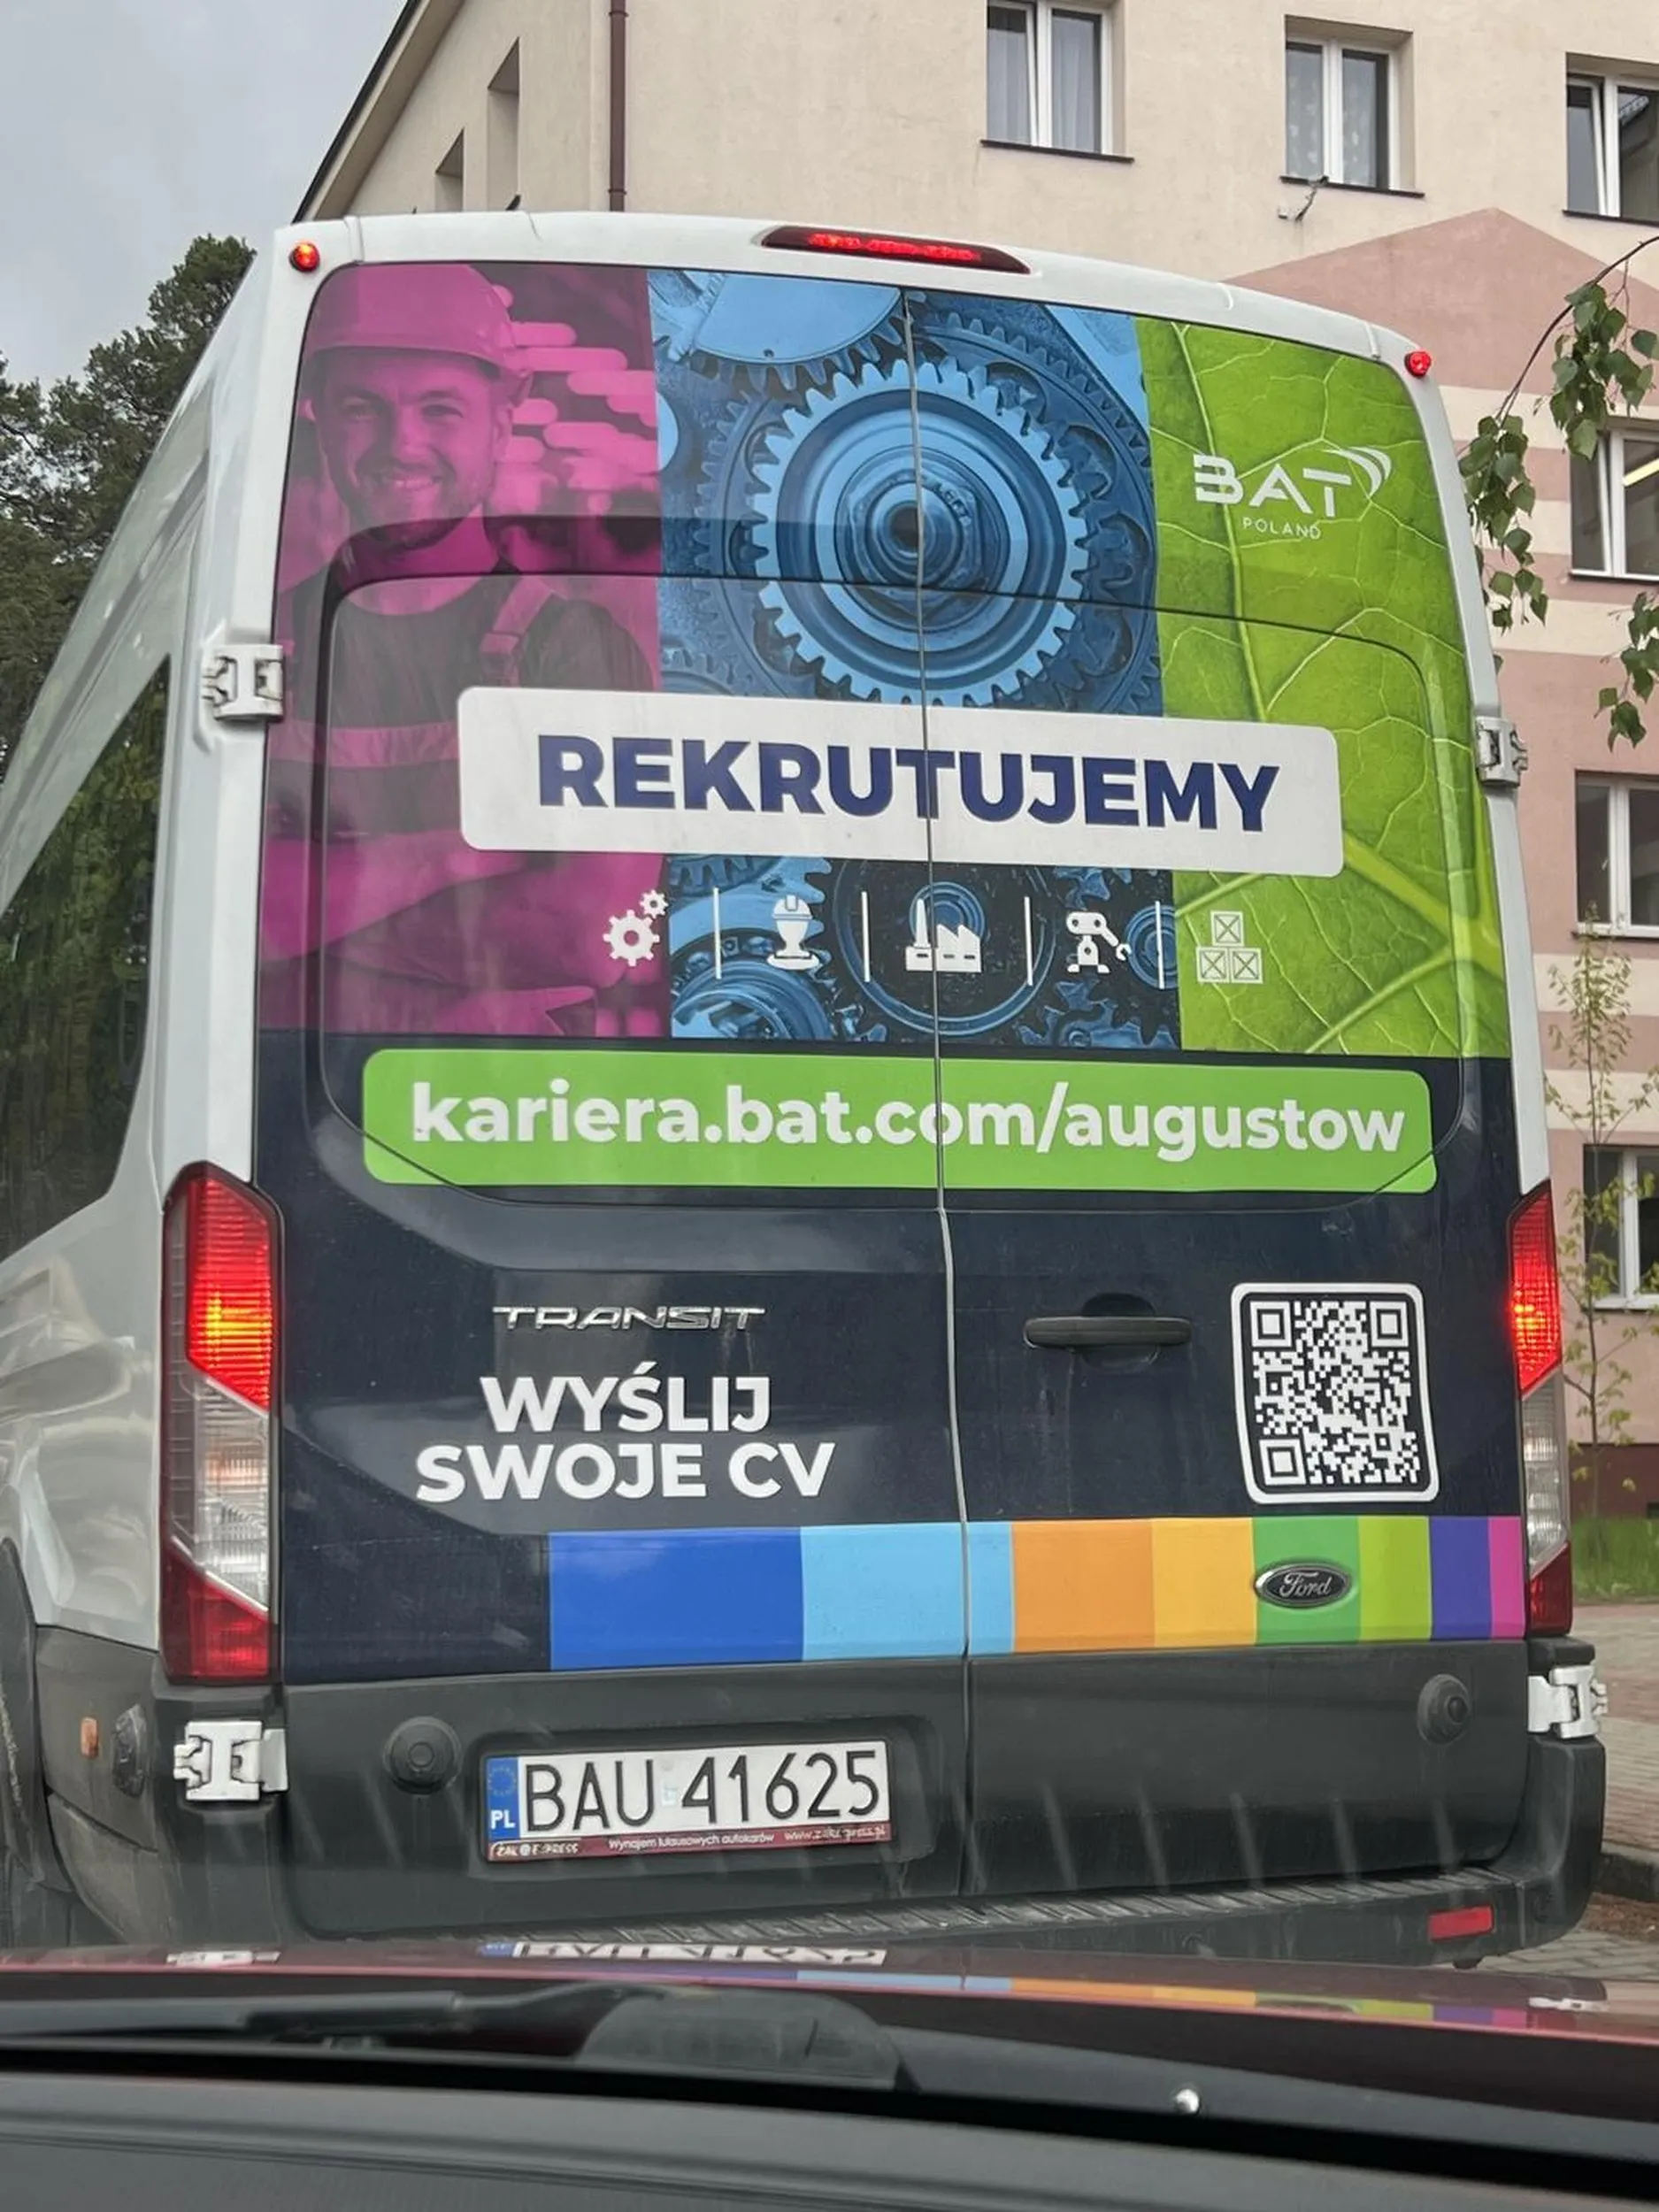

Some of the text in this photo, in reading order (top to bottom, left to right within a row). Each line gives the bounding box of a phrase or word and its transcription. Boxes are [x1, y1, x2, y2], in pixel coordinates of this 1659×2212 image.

[1193, 453, 1353, 518] BAT
[1241, 517, 1322, 540] POLAND
[537, 733, 1280, 832] REKRUTUJEMY
[412, 1078, 1405, 1163] kariera.bat.com/augustow
[492, 1306, 765, 1330] TRANSIT
[480, 1361, 770, 1432] WYŚLIJ
[416, 1442, 835, 1502] SWOJE CV
[1279, 1571, 1332, 1597] Ford
[490, 1810, 515, 1830] PL
[526, 1750, 879, 1832] BAU 41625
